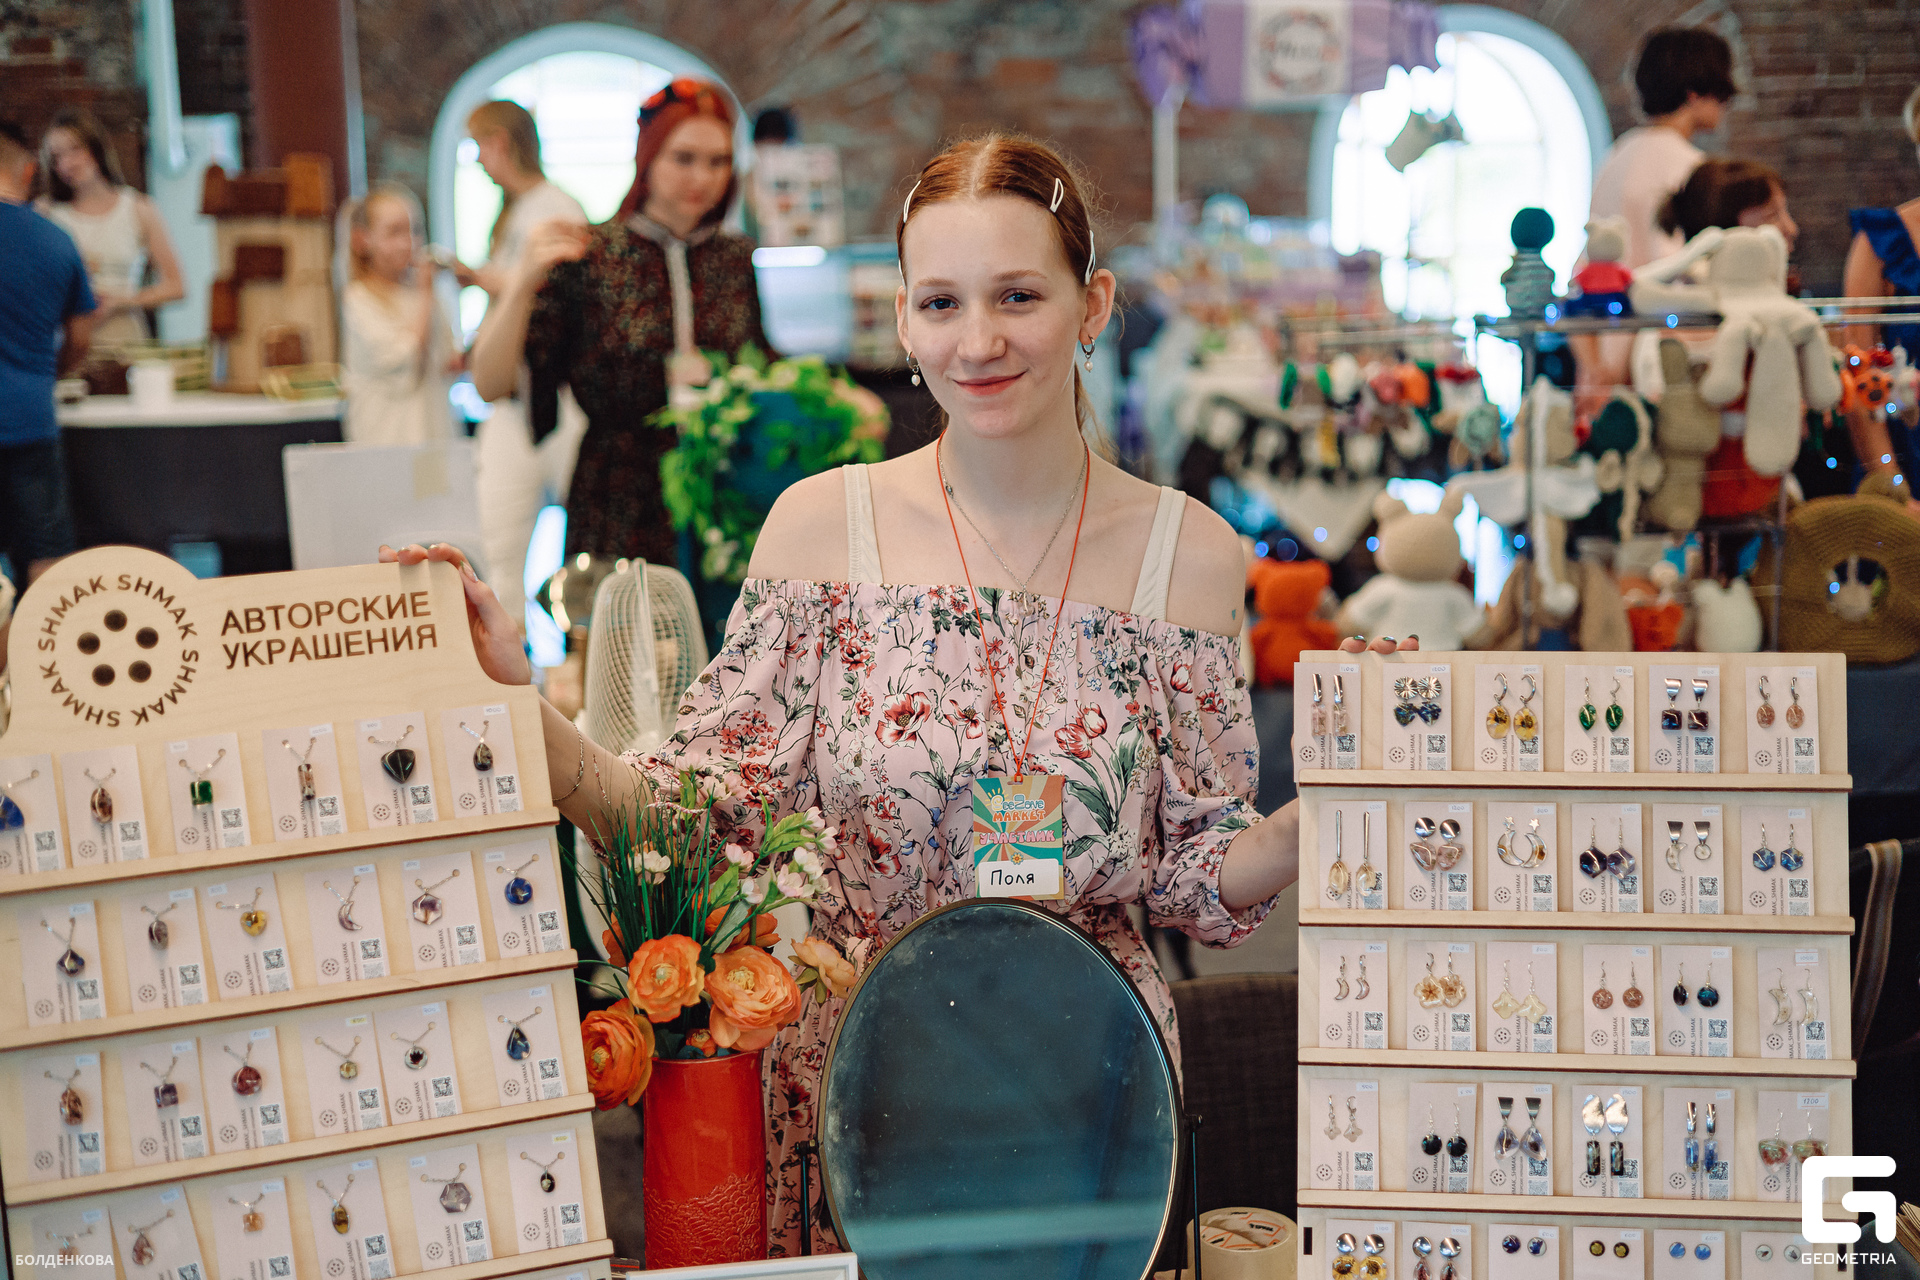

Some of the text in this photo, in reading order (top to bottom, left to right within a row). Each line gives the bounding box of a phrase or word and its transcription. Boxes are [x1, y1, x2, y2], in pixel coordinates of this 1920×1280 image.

[38, 576, 108, 652] SHMAK
[117, 574, 198, 641] SHMAK
[220, 590, 432, 637] АВТОРСКИЕ
[222, 623, 438, 670] УКРАШЕНИЯ
[39, 660, 121, 727] SHMAK
[130, 649, 199, 726] SHMAK
[979, 830, 1056, 845] УЧАСТНИК
[992, 809, 1046, 822] MARKET
[990, 869, 1035, 886] Поля
